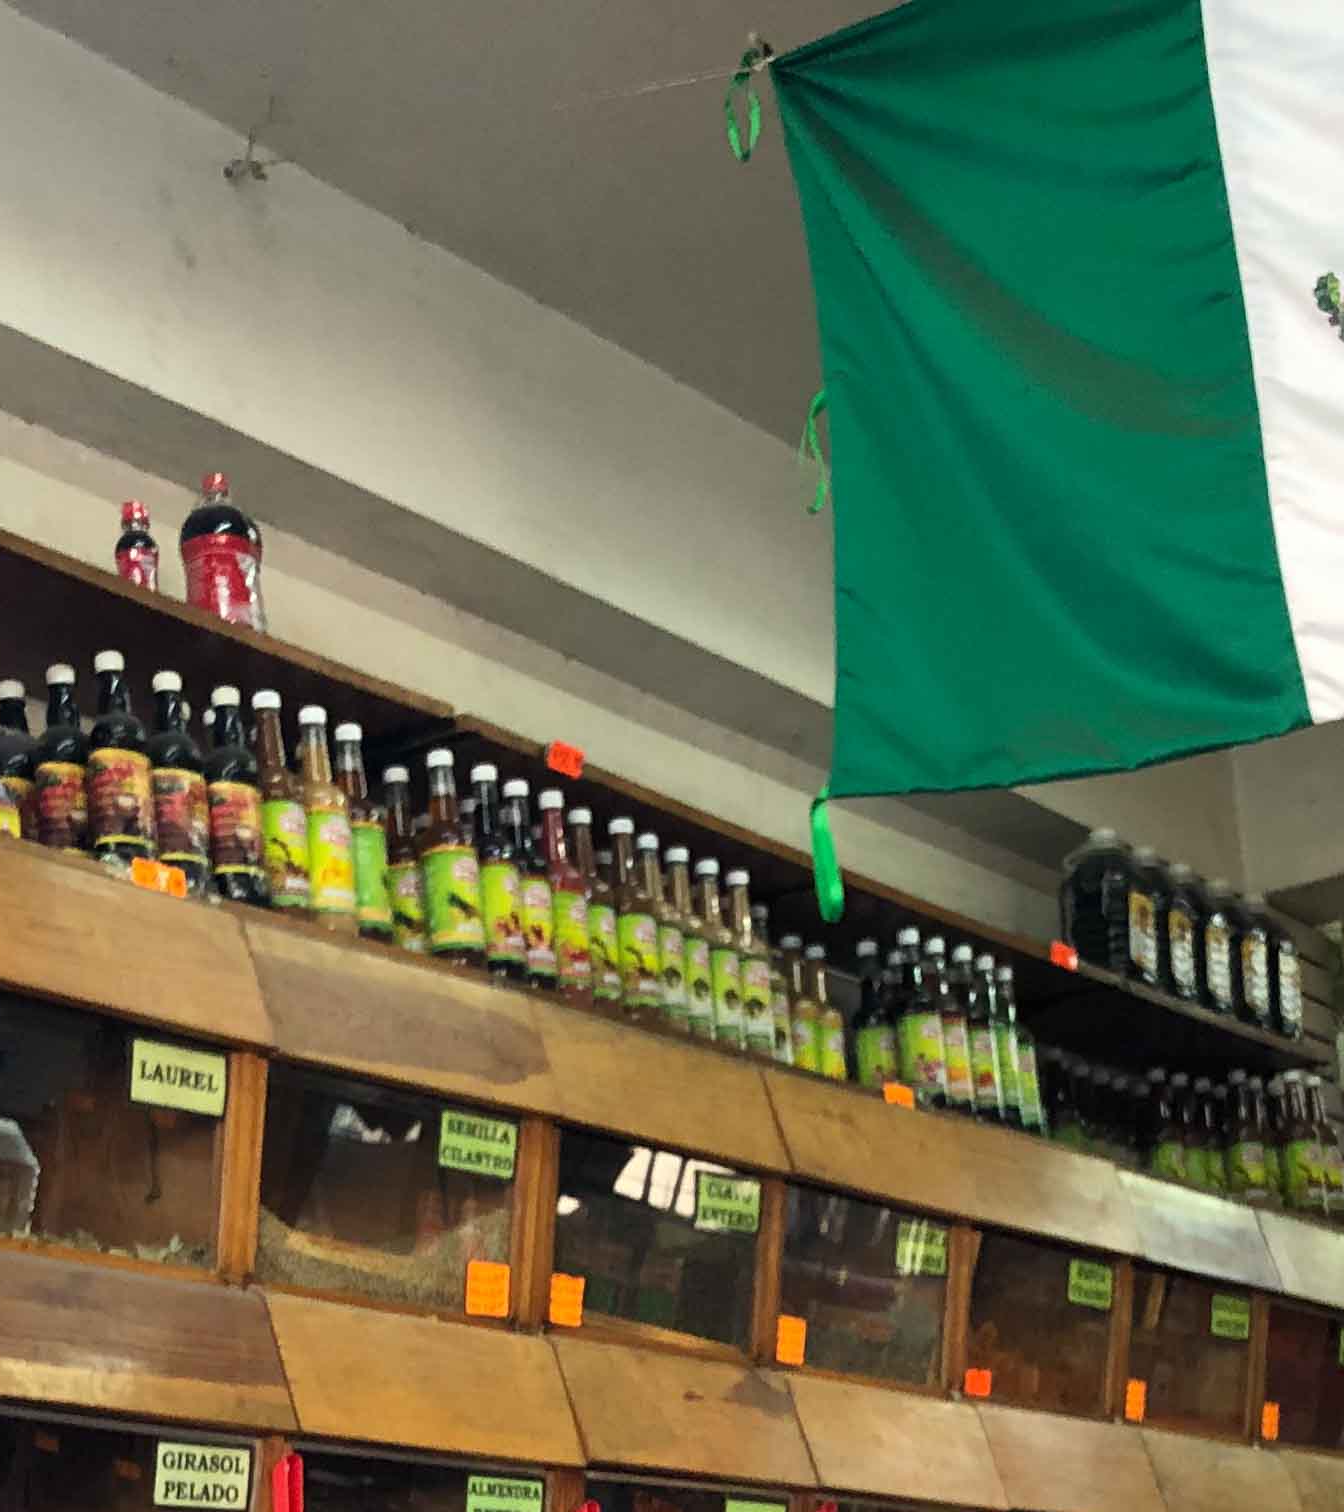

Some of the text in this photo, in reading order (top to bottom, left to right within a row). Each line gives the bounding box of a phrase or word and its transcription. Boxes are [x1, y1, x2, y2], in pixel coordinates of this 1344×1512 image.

[139, 1060, 220, 1094] LAUREL
[161, 1450, 246, 1476] GIRASOL
[162, 1478, 240, 1504] PELADO
[467, 1481, 542, 1501] ALMENDRA
